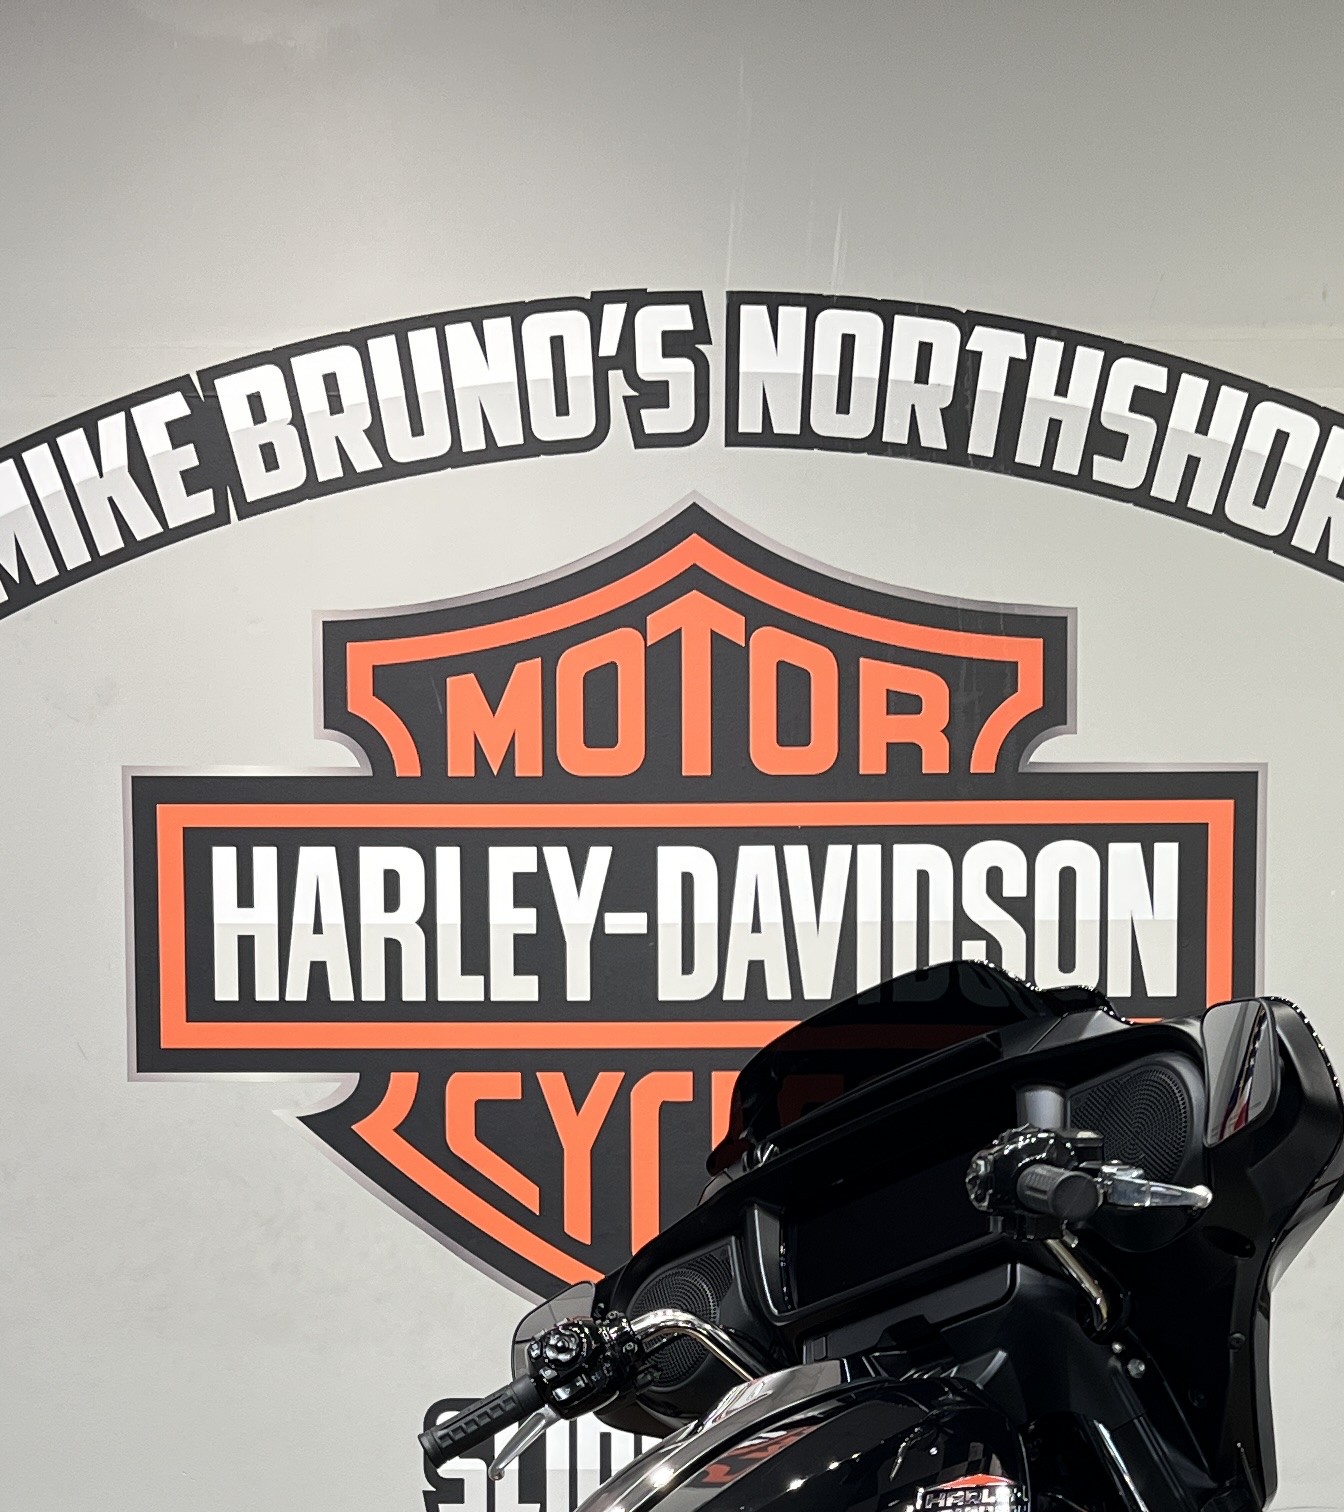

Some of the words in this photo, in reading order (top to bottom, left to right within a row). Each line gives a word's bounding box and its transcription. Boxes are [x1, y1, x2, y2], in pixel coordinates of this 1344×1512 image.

[213, 302, 696, 503] BRUNO'S
[448, 592, 950, 777] MOTOR
[211, 840, 1180, 1002] HARLEY-DAVIDSON
[447, 1071, 739, 1255] CYC
